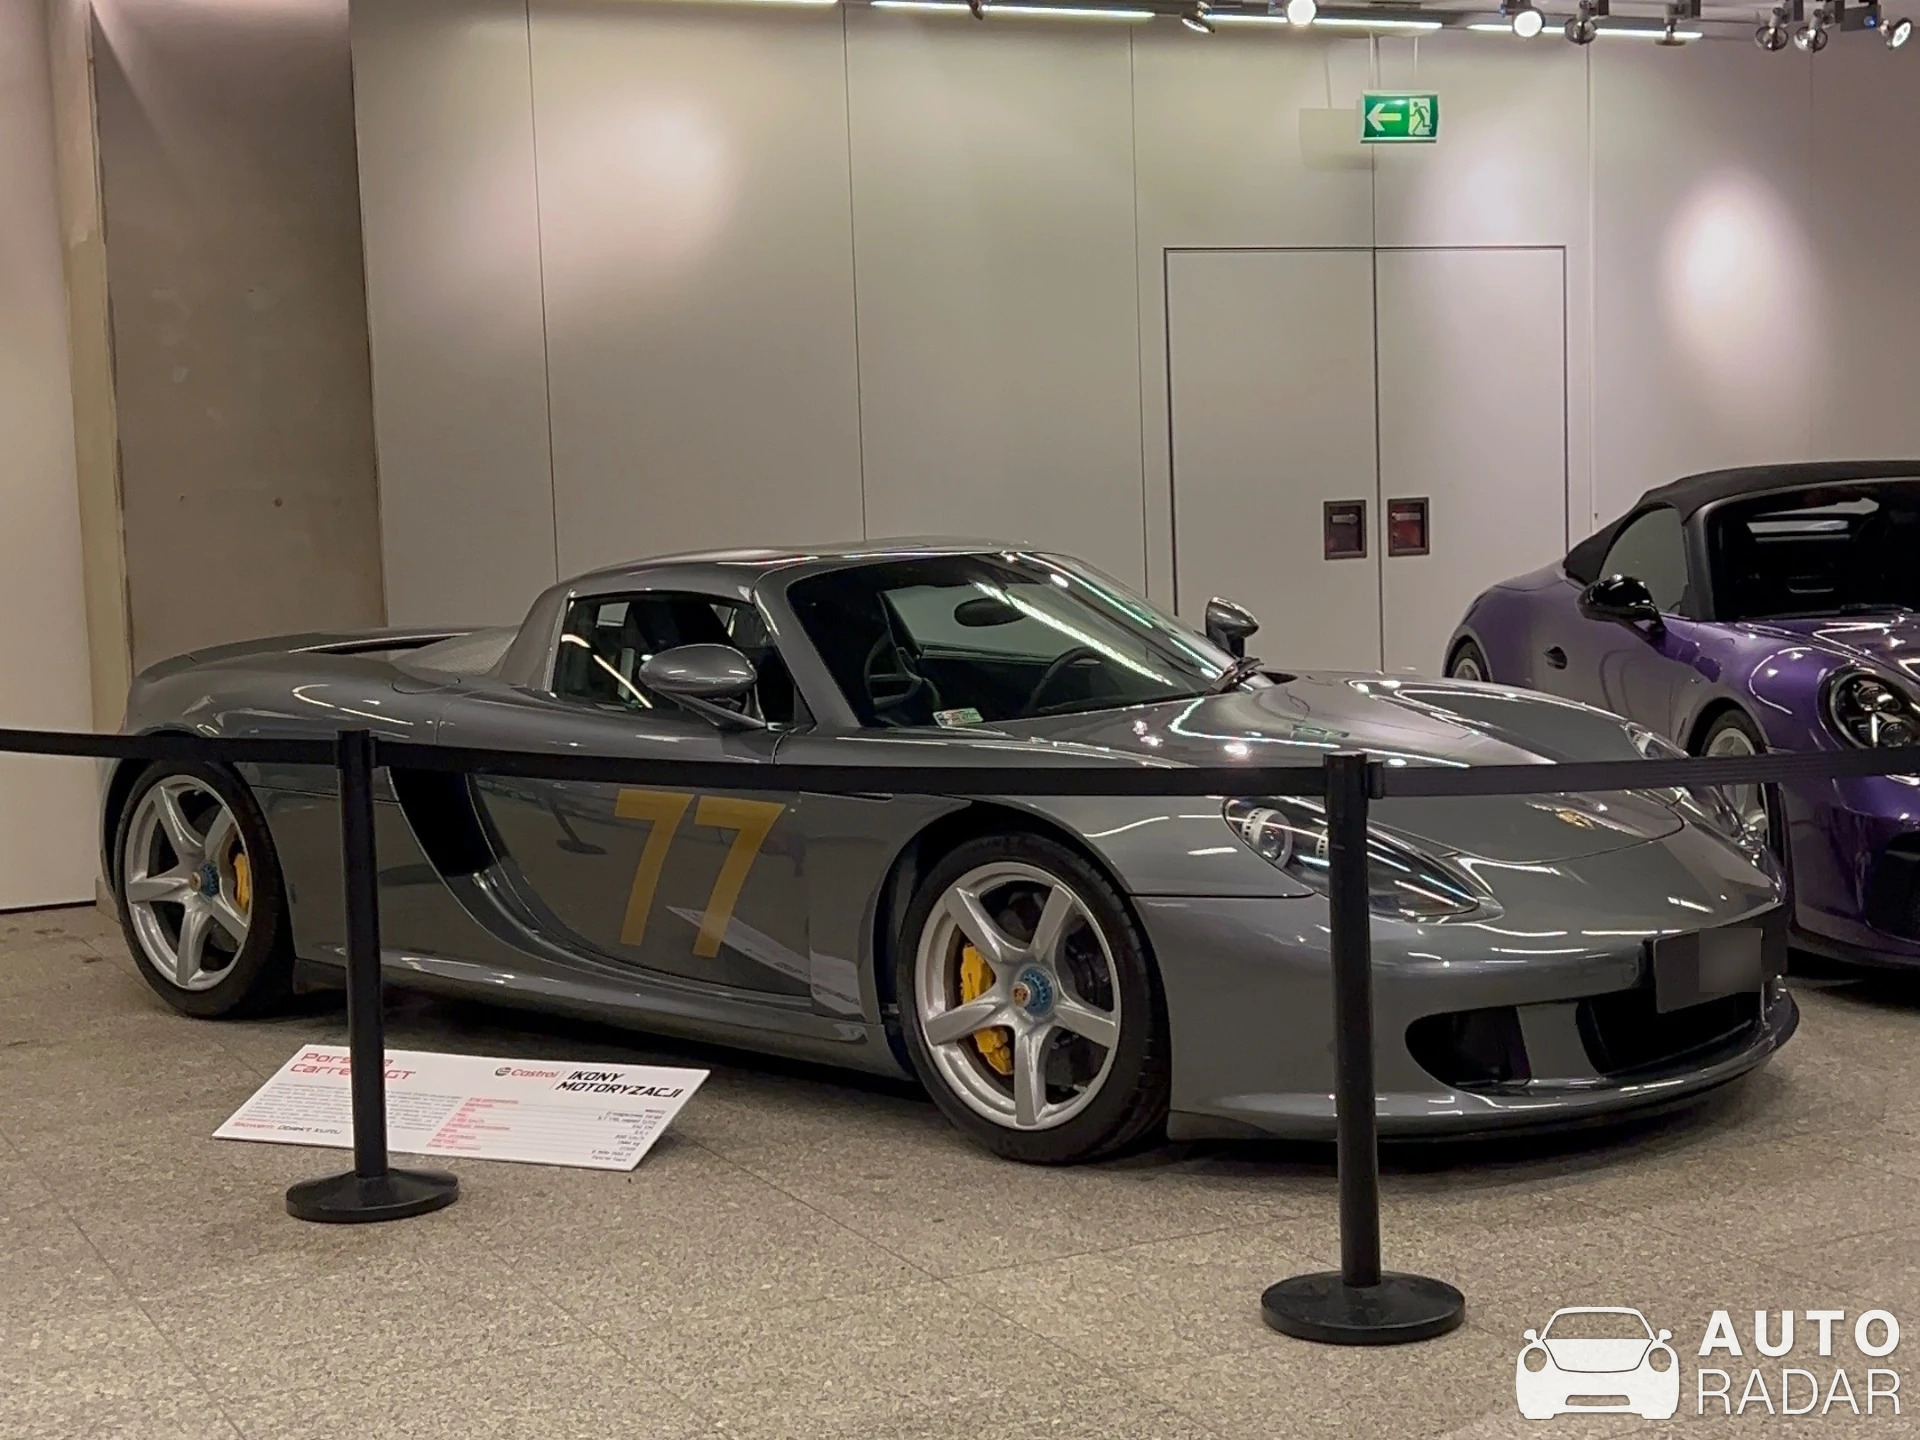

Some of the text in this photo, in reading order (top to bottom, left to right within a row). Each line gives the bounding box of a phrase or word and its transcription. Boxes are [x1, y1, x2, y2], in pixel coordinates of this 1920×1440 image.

[614, 787, 787, 958] 77
[300, 1052, 394, 1067] Porse
[290, 1063, 417, 1080] Carre GT
[510, 1068, 560, 1080] Castrol
[566, 1070, 626, 1083] IKONY
[555, 1081, 685, 1099] MOTORYZACJI
